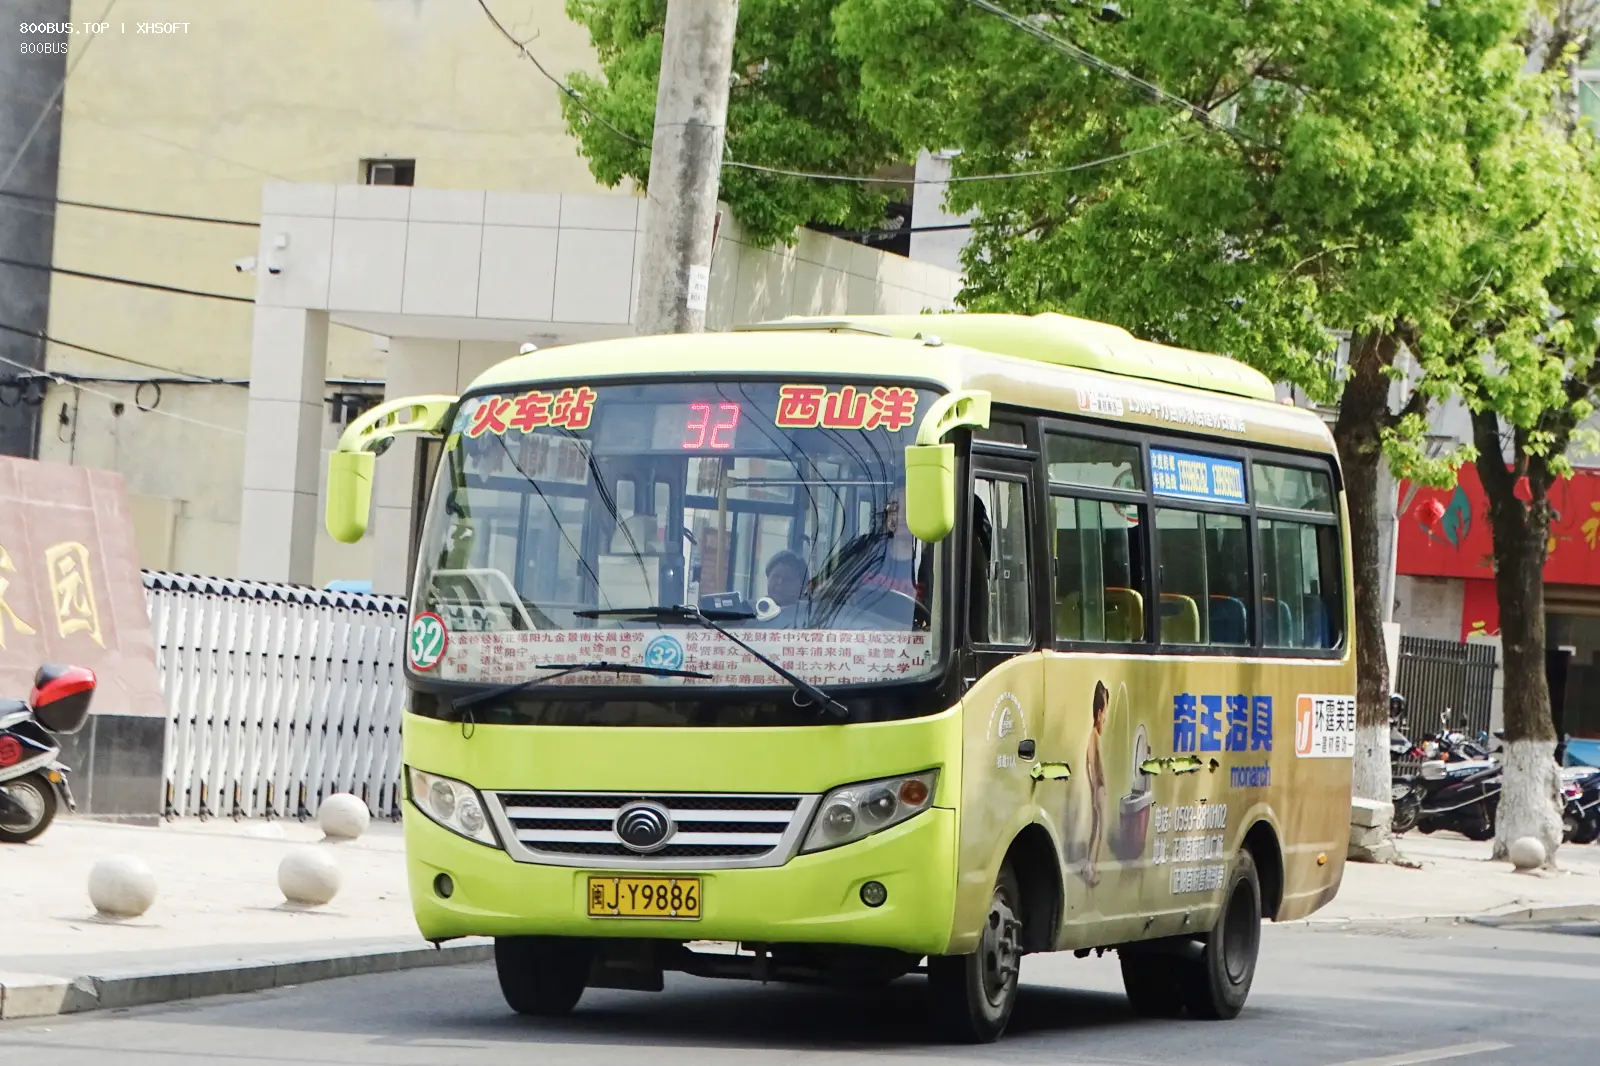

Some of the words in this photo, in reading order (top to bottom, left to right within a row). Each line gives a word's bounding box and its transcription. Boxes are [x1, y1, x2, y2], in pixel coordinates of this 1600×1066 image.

[468, 385, 597, 438] 火车站
[683, 402, 740, 448] 32
[776, 384, 918, 431] 西山洋
[411, 619, 443, 664] 32
[650, 645, 678, 667] 32
[1173, 693, 1273, 752] 帝王洁具
[1315, 700, 1355, 732] 环霆美居
[1230, 760, 1272, 788] monarch
